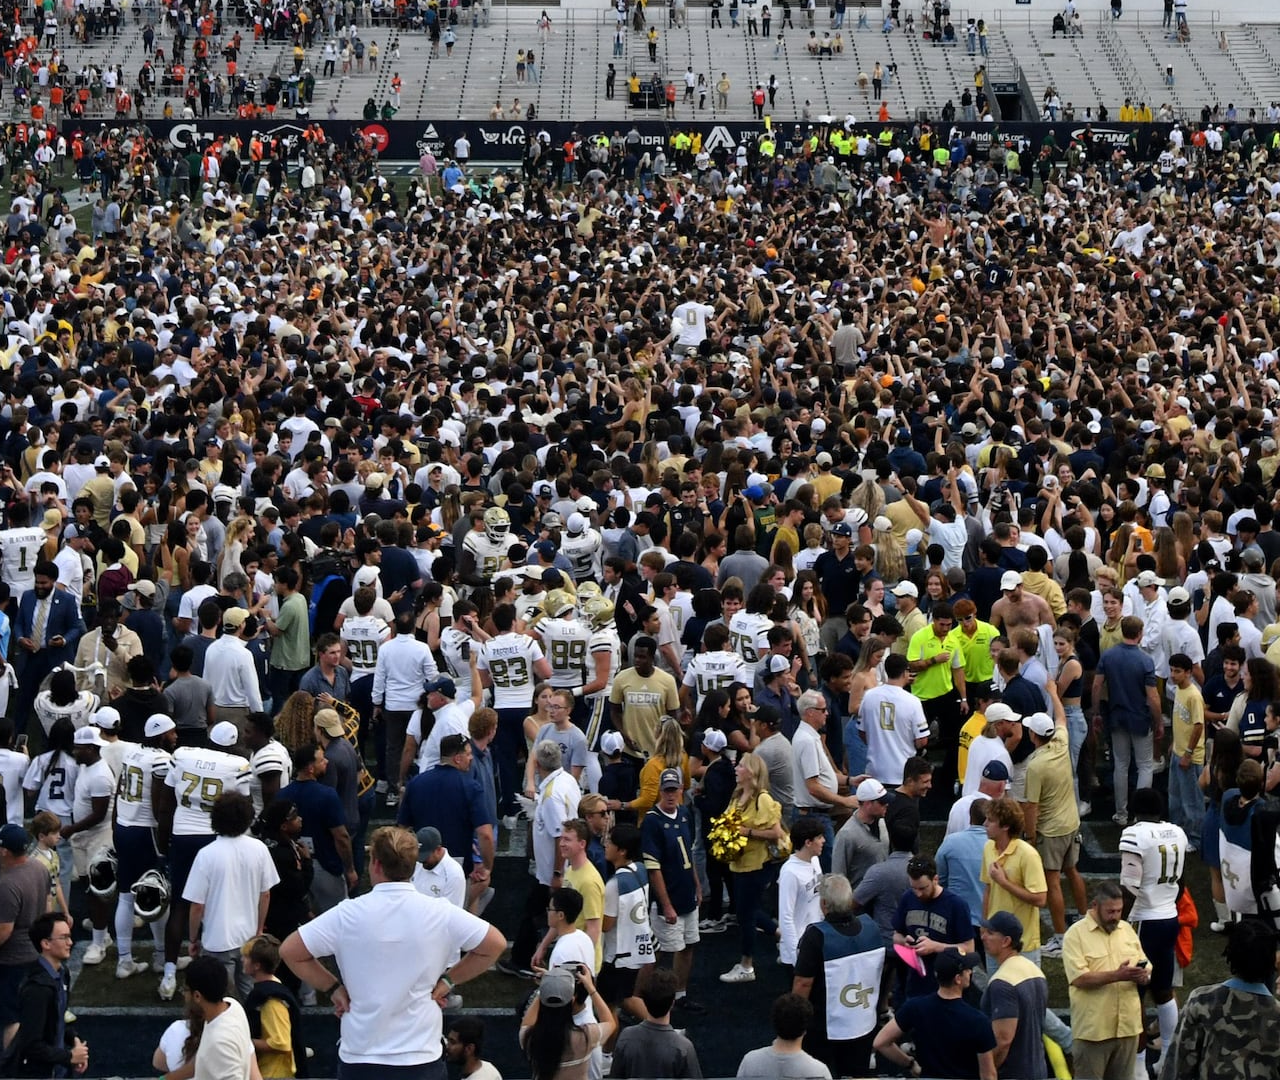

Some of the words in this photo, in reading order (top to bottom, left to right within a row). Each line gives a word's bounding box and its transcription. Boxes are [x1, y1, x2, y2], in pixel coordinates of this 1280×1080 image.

[416, 140, 445, 151] Georgia
[18, 546, 28, 572] 1
[346, 639, 378, 669] 20
[551, 639, 586, 670] 89
[489, 655, 530, 687] 83
[628, 693, 661, 705] TECH
[880, 701, 896, 731] 0
[1248, 713, 1256, 724] 0
[195, 759, 217, 771] FLOYD
[49, 767, 65, 800] 2
[181, 770, 224, 812] 79
[676, 835, 691, 870] 1
[1157, 844, 1179, 885] 11
[638, 943, 653, 955] 95
[839, 981, 874, 1009] GT
